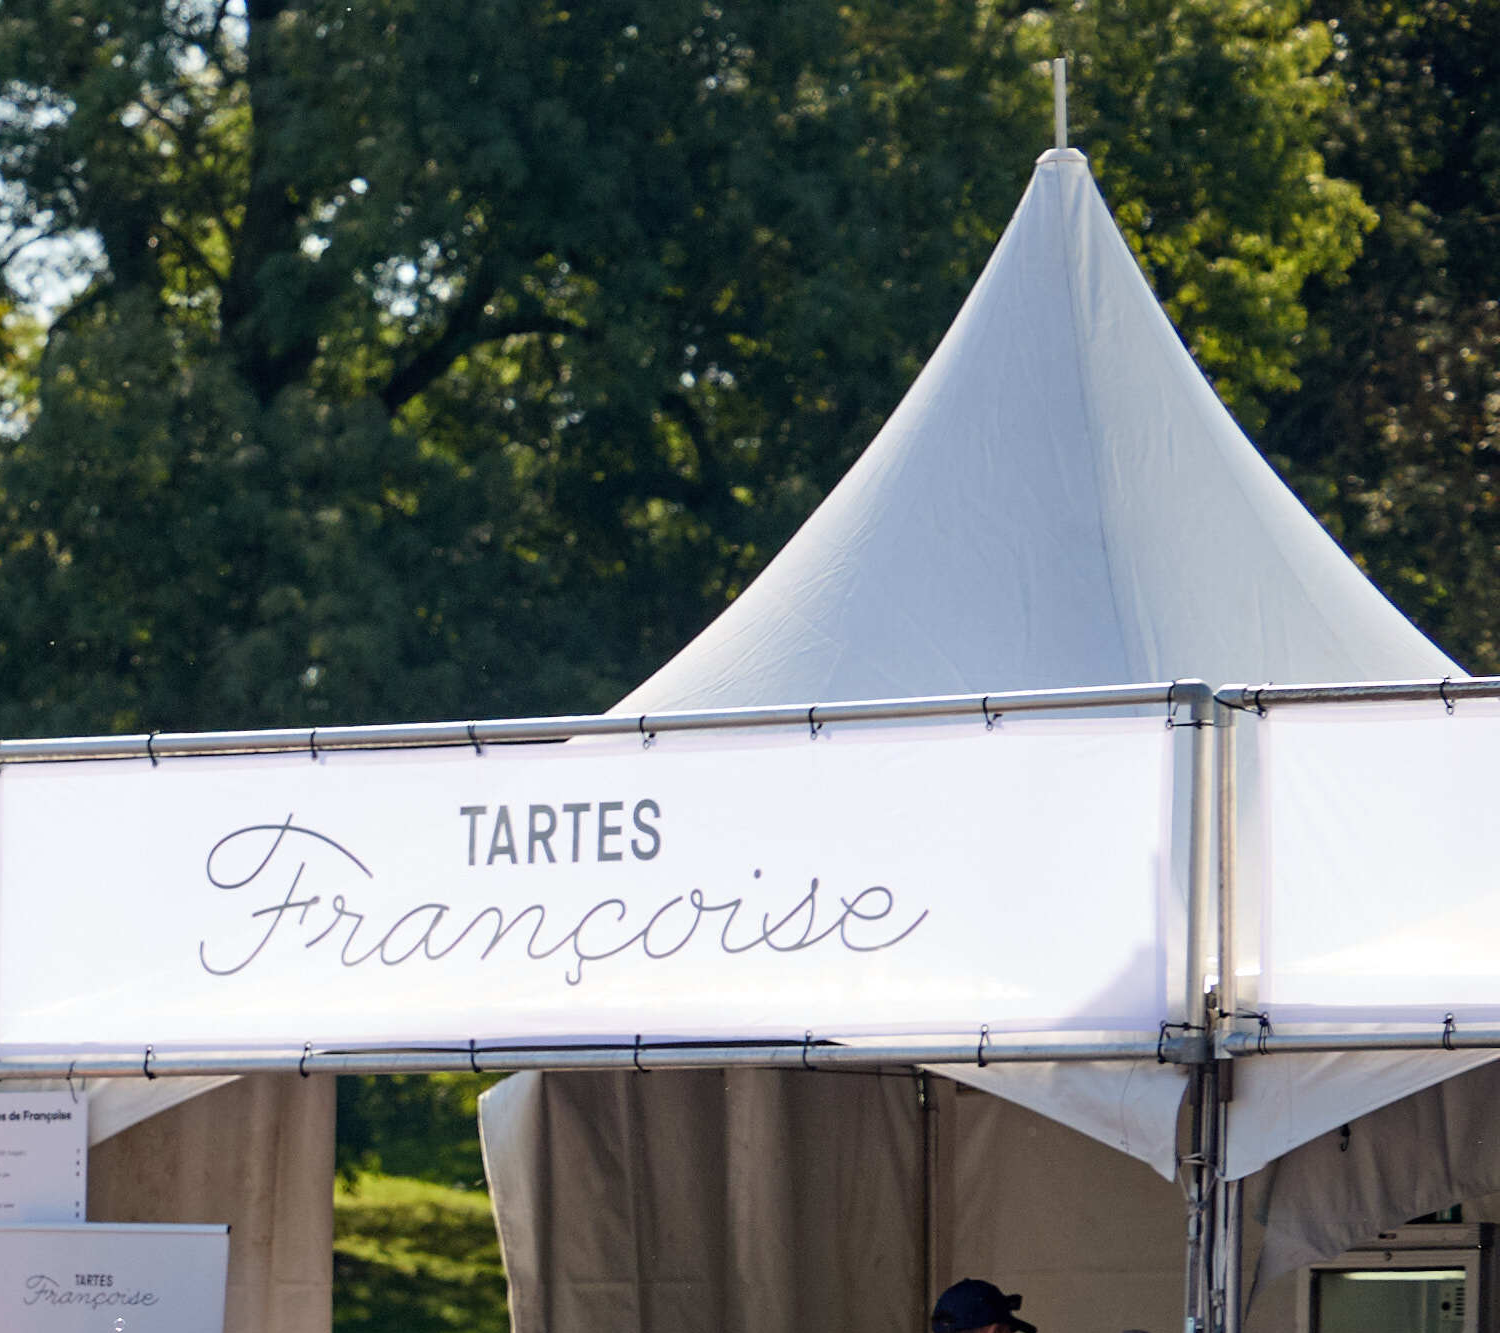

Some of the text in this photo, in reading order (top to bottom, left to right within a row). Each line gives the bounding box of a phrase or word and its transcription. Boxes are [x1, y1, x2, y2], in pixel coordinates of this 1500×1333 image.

[459, 799, 663, 867] TARTES
[199, 813, 930, 986] Françoise
[8, 1110, 21, 1121] de
[22, 1274, 160, 1310] Françoise
[75, 1273, 114, 1288] TARTES
